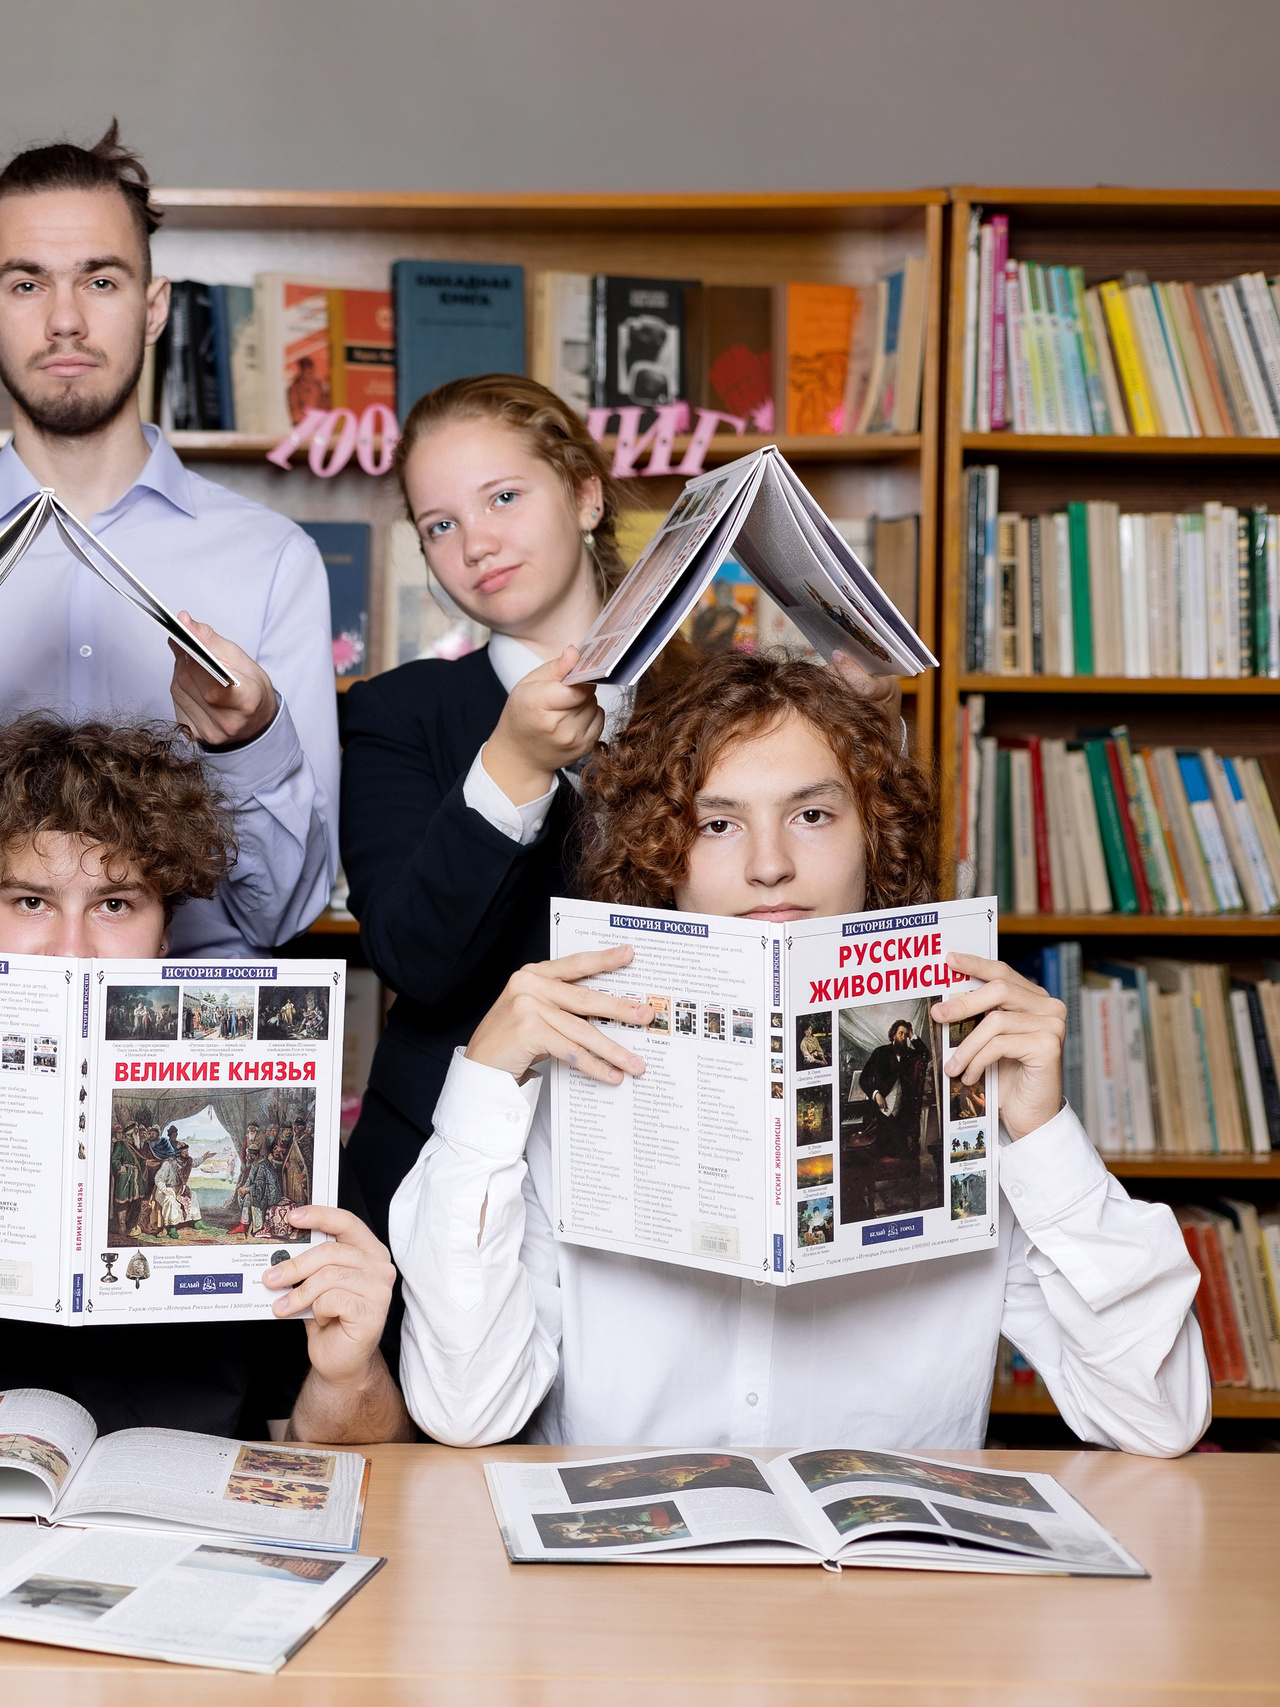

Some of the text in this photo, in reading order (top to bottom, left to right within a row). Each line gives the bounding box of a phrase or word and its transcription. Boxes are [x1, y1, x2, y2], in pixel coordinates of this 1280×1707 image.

[267, 403, 400, 477] 100
[587, 403, 748, 478] ИГ
[612, 915, 707, 935] ИСТОРИЯ РОССИИ
[845, 913, 936, 935] ИСТОРИЯ РОССИИ
[839, 933, 942, 968] РУССКИЕ
[165, 968, 274, 978] ИСТОРИЯ РОССИИ
[115, 1061, 316, 1081] ВЕЛИКИЕ КНЯЗЬЯ
[774, 1117, 782, 1205] РУССКИЕ ЖИВОПИСЦЫ
[75, 1182, 84, 1251] ВЕЛИКИЕ КНЯЗЬЯ
[869, 1224, 916, 1238] БЕЛЫЙ ГОРОД
